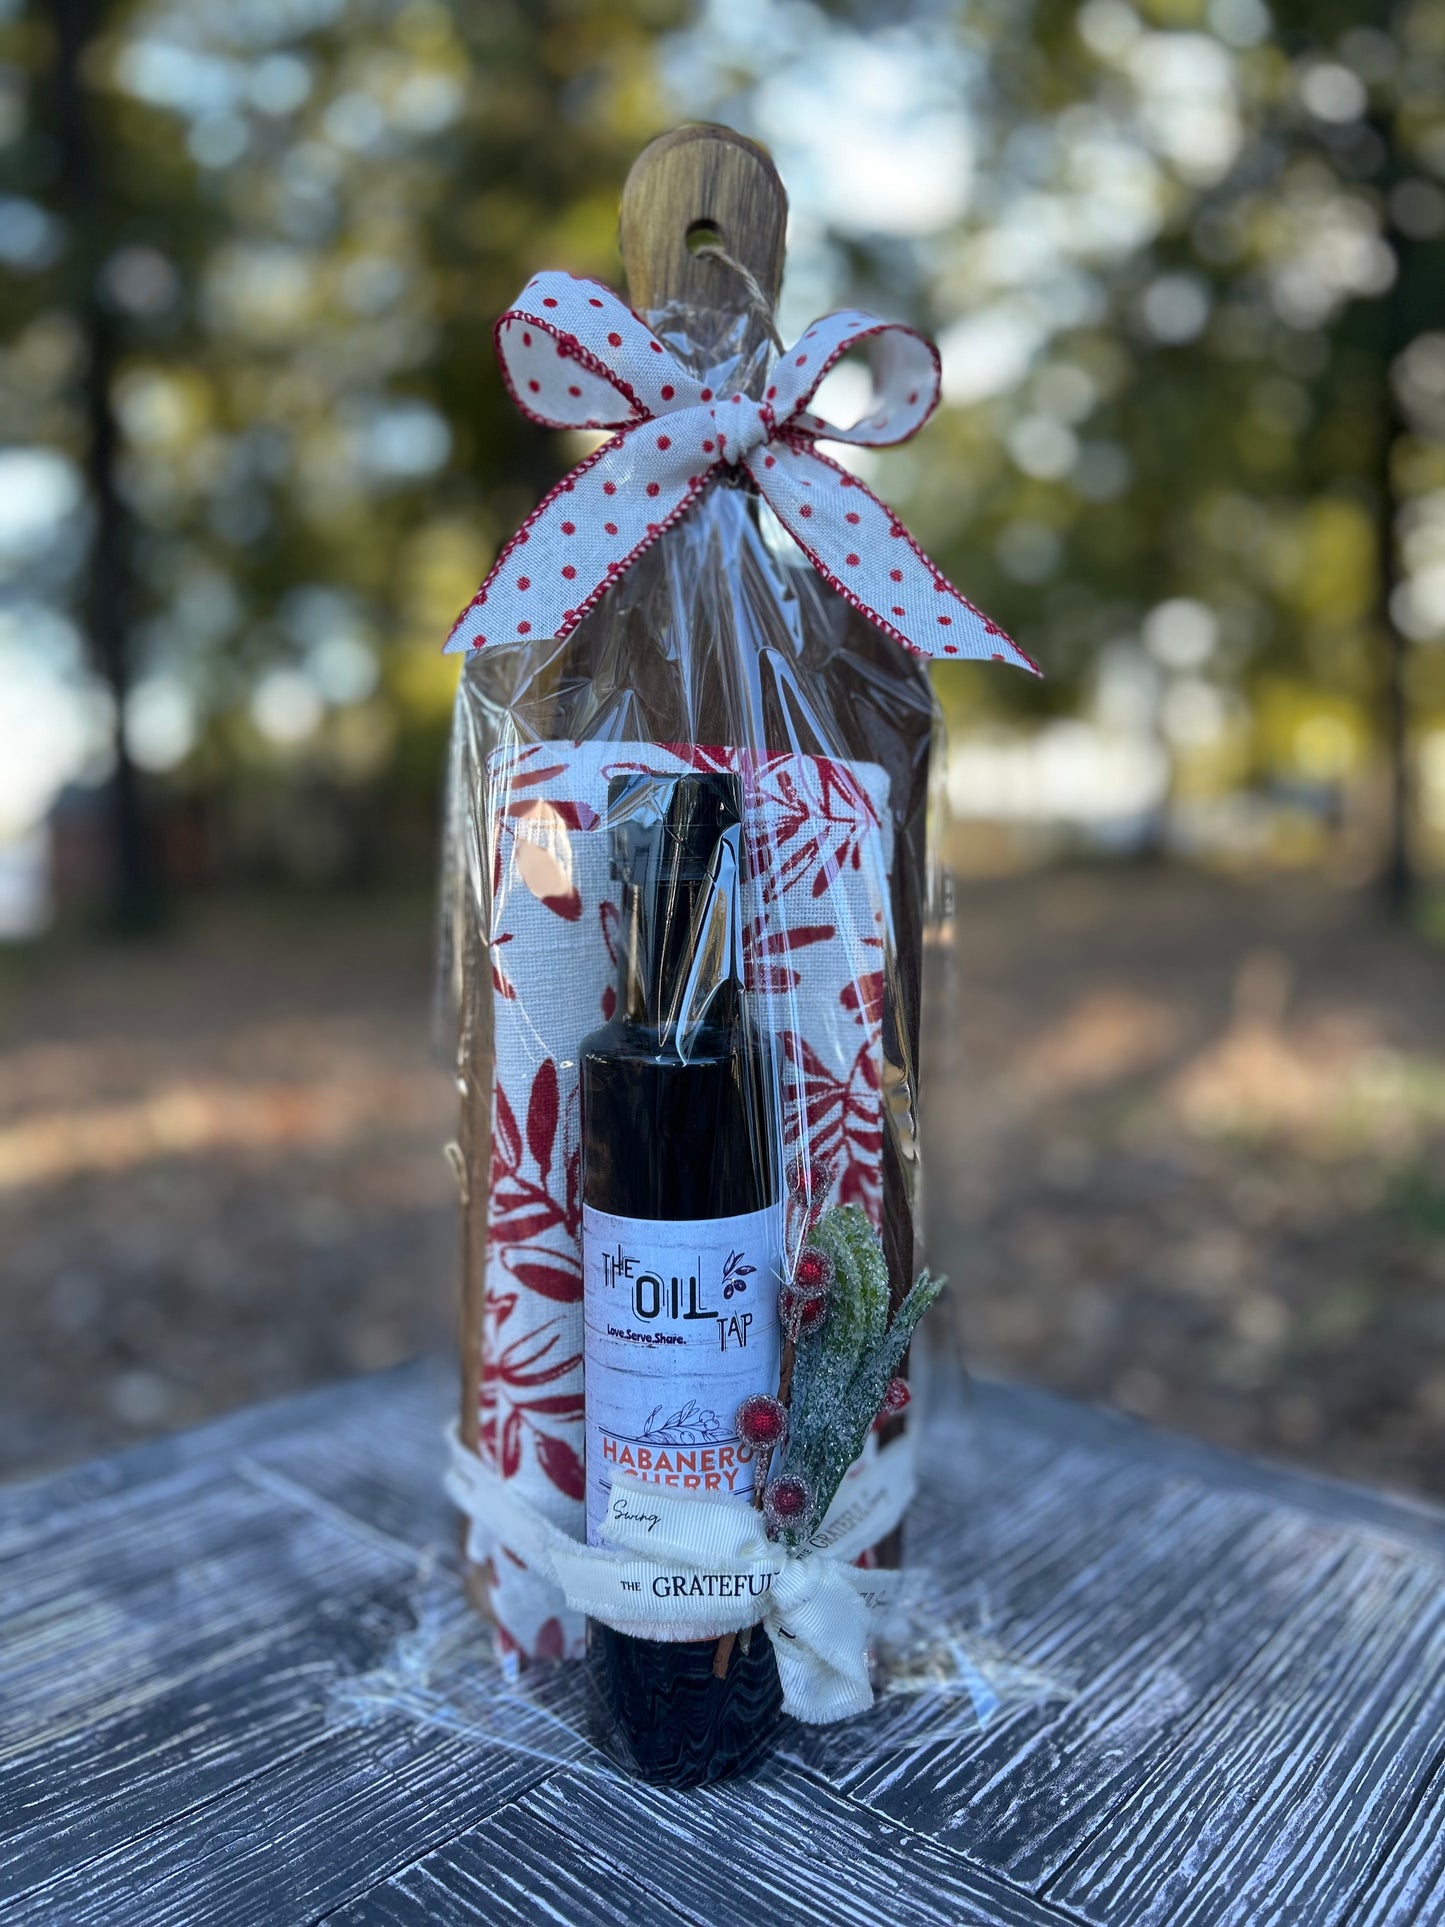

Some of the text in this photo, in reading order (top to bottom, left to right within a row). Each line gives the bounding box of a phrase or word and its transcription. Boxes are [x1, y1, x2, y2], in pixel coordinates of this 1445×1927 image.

[602, 1244, 753, 1351] THE OIL TAP
[603, 1436, 755, 1473] HABANERO
[612, 1499, 662, 1532] Swing
[620, 1580, 641, 1592] THE
